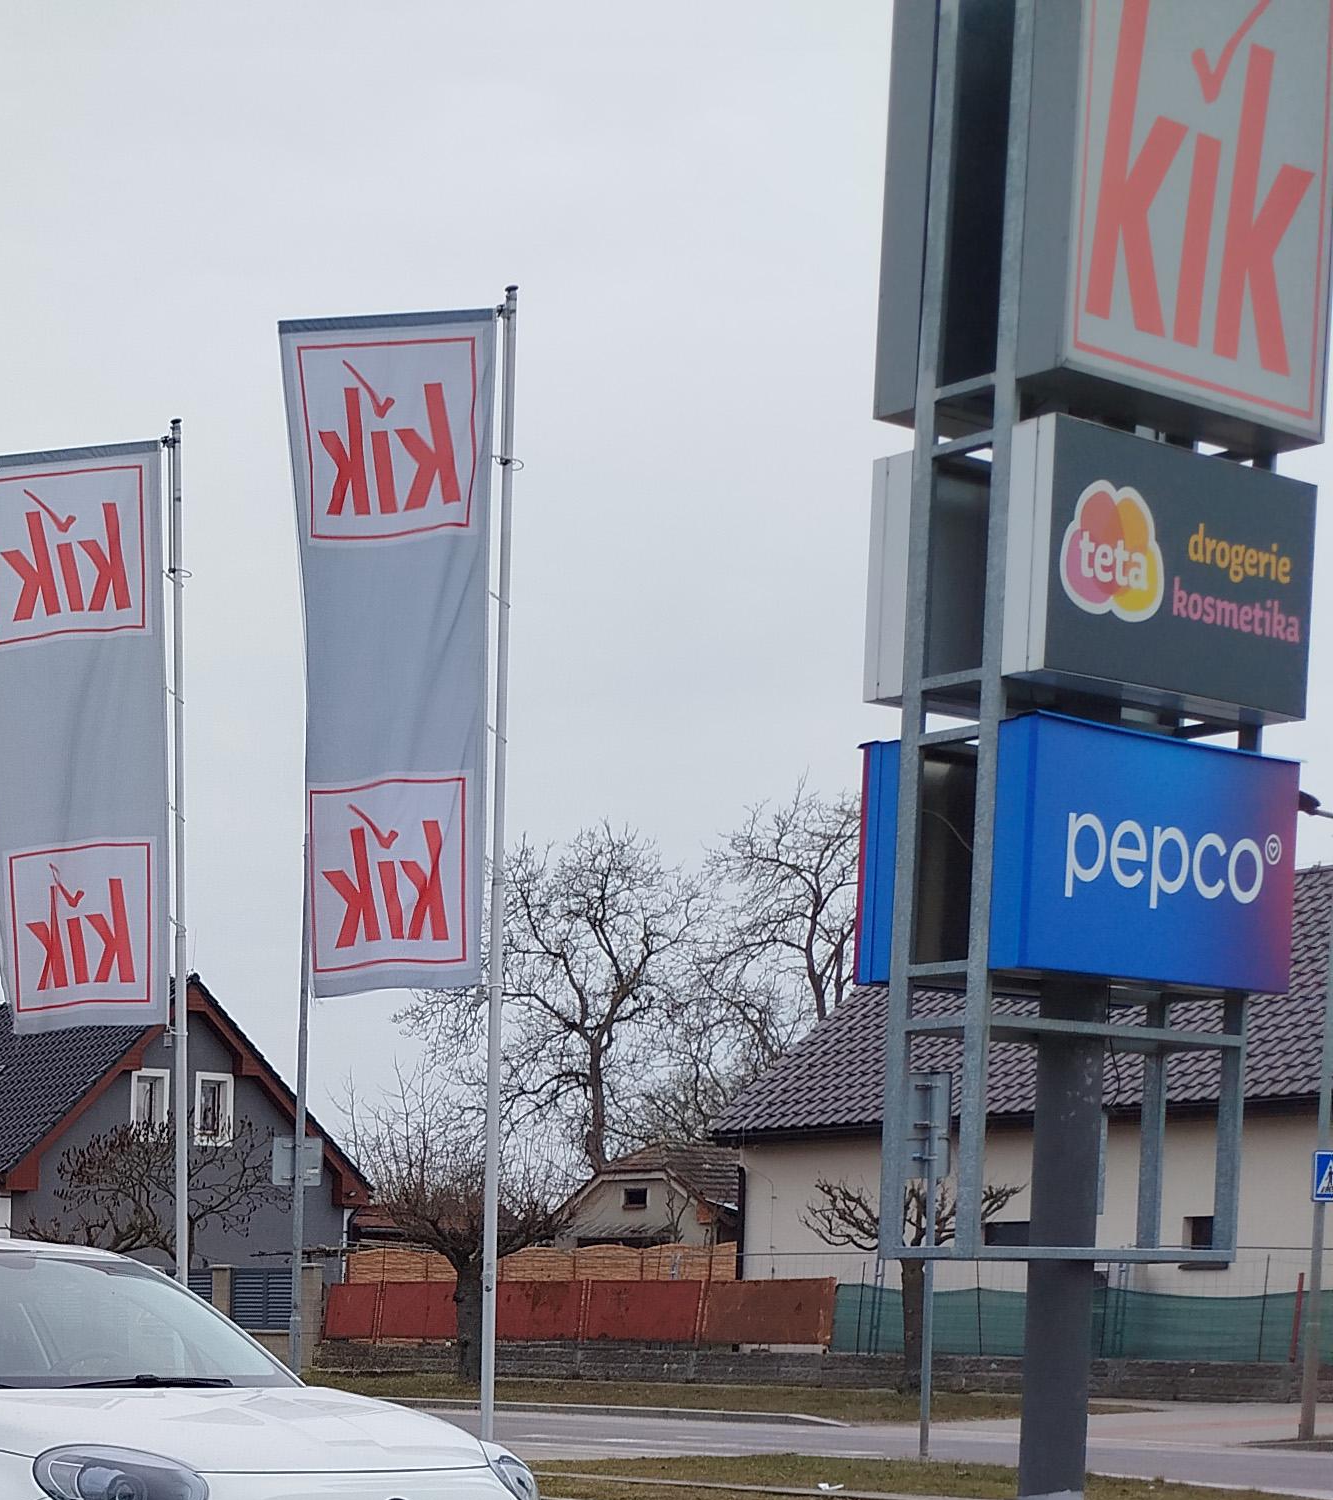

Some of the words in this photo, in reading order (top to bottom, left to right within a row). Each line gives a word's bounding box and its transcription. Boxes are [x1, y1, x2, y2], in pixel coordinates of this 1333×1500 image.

[1079, 530, 1148, 591] teta
[1189, 524, 1290, 584] drogerie
[1172, 577, 1300, 644] kosmetika
[1064, 812, 1264, 909] pepco
